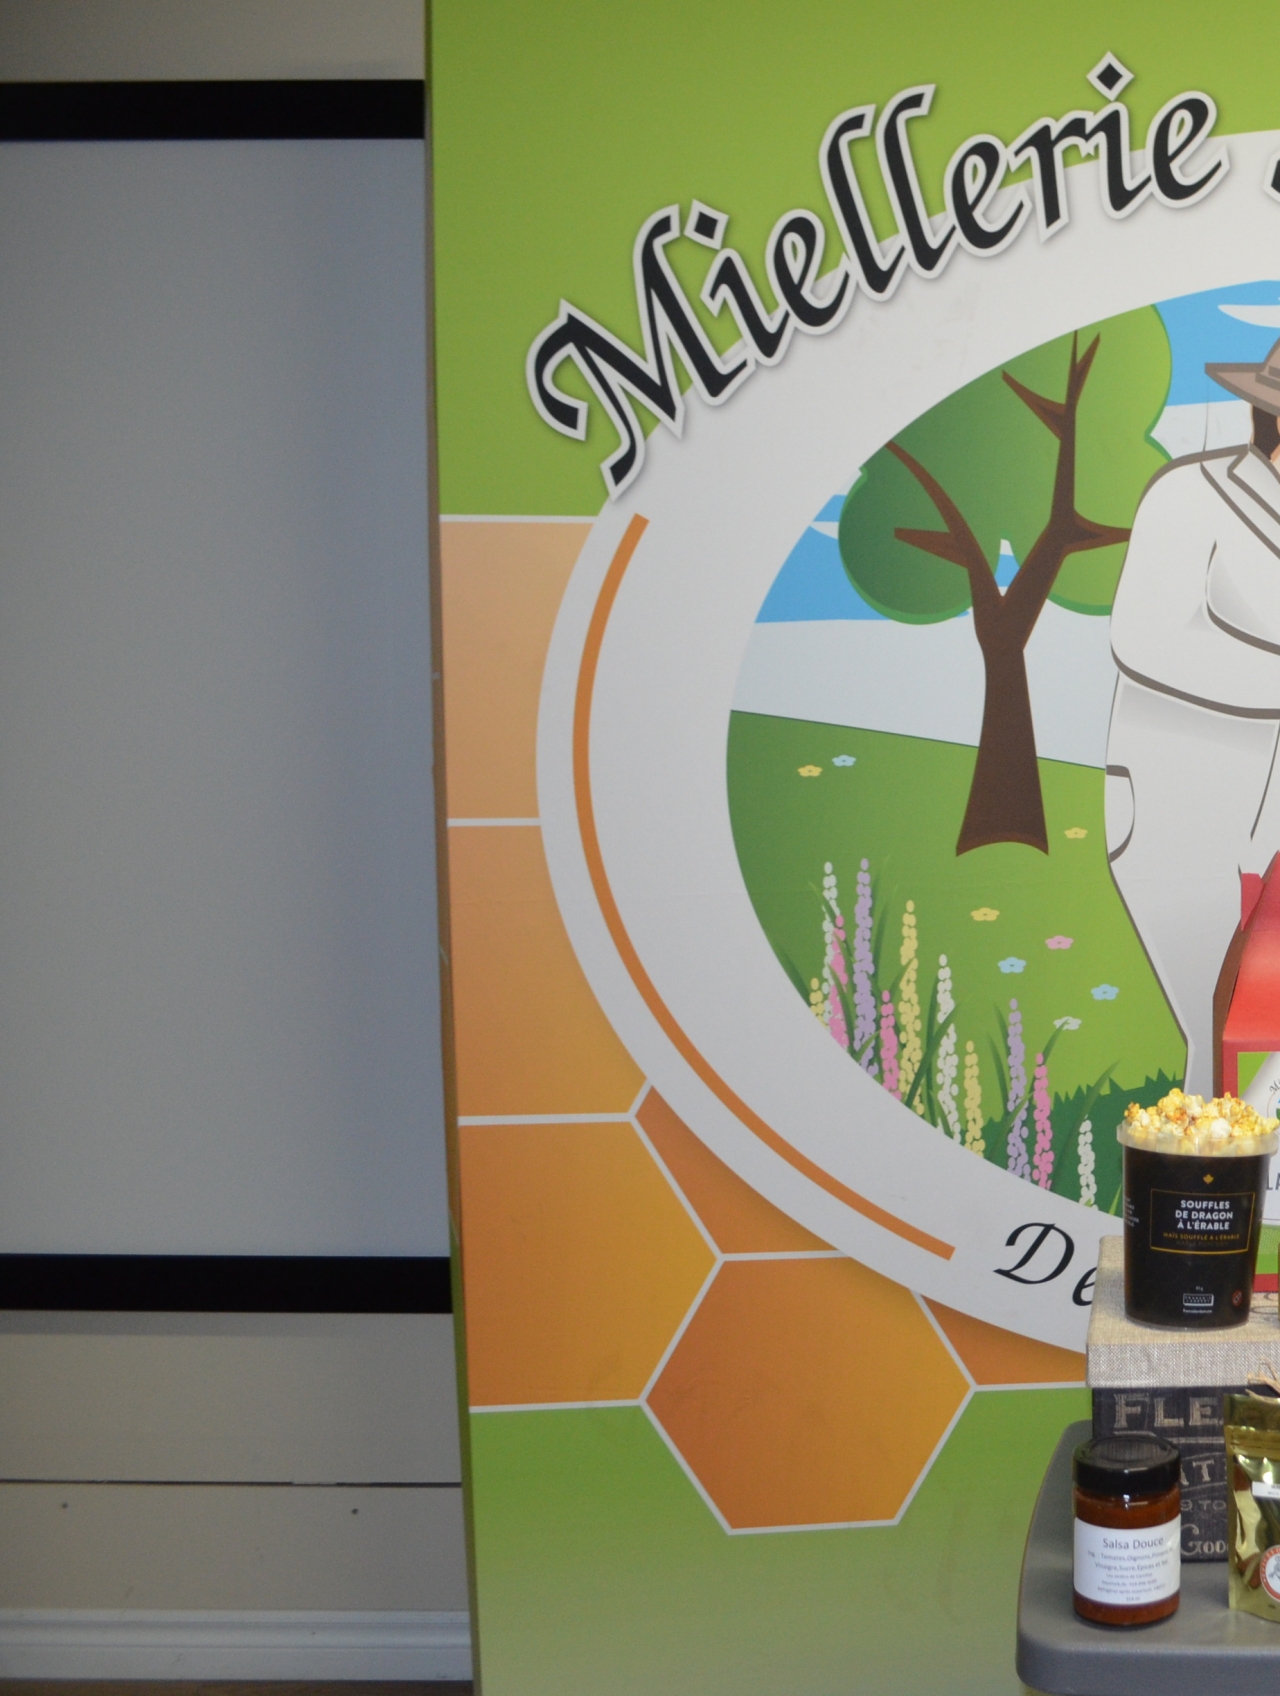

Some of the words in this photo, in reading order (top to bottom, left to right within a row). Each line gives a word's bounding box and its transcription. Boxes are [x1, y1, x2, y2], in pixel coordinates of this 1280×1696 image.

[530, 56, 1228, 493] Miellerie
[1180, 1200, 1230, 1209] SOUFFLES
[1175, 1210, 1188, 1219] DE
[1191, 1211, 1233, 1220] DRAGON
[1177, 1219, 1184, 1229] À
[1187, 1220, 1230, 1230] L'ÉRABLE
[1113, 1393, 1224, 1429] FLE
[1102, 1538, 1129, 1550] Salsa
[1133, 1537, 1164, 1549] Douce
